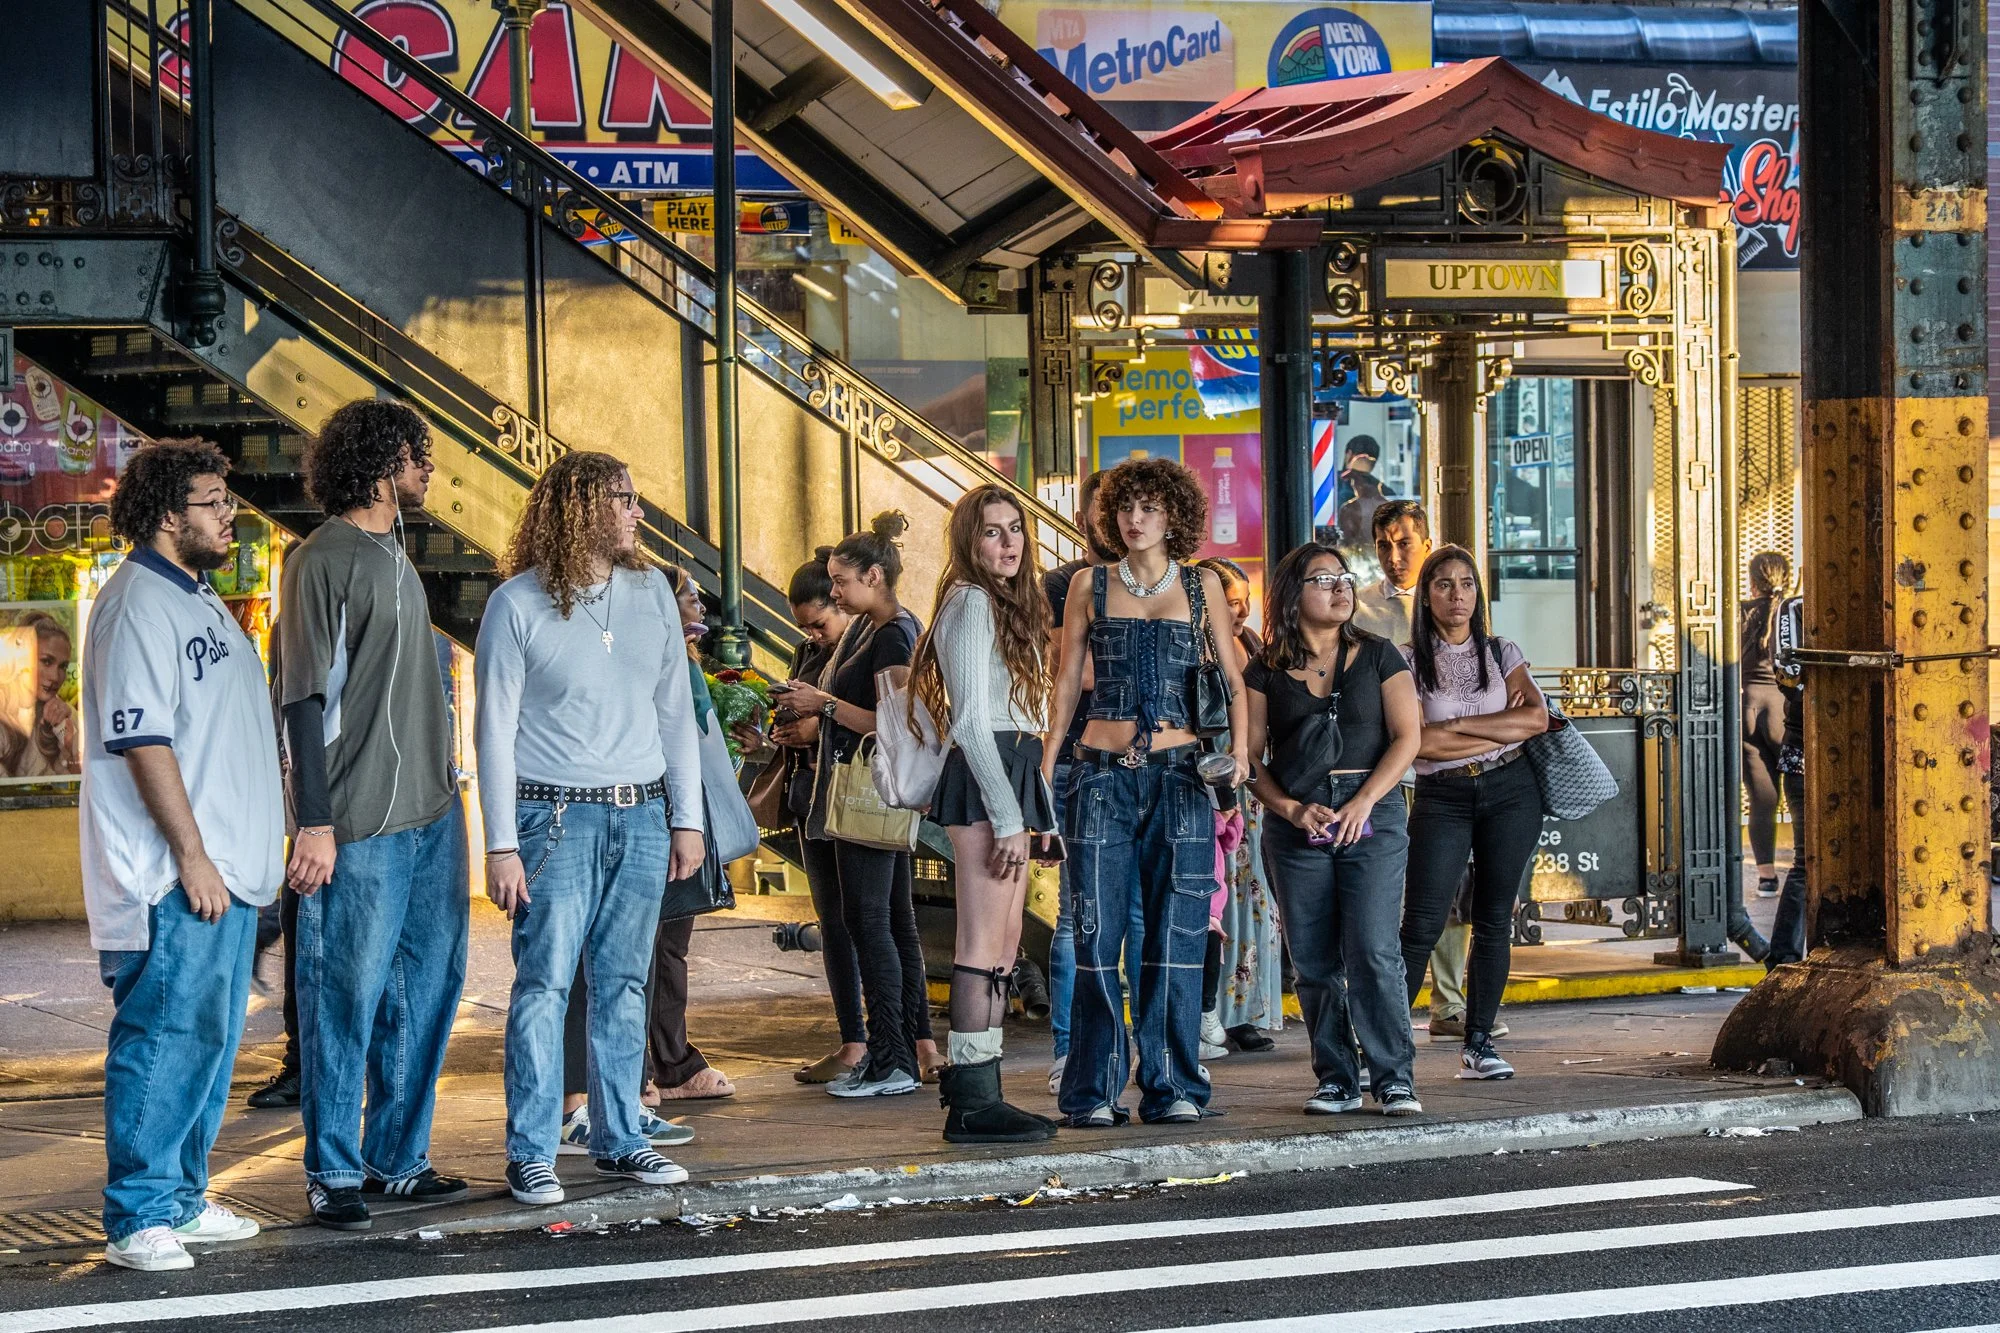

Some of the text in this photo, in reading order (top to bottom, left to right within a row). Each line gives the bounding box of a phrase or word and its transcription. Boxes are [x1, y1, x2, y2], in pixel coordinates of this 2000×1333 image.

[1324, 22, 1367, 45] NEW
[1037, 20, 1220, 95] MetroCard
[1329, 45, 1381, 76] YORK
[1589, 87, 1679, 130] Estilo
[610, 161, 679, 184] ATM
[667, 202, 708, 216] PLAY
[1428, 264, 1560, 291] UPTOWN
[1118, 368, 1197, 391] lemo
[1513, 437, 1549, 464] OPEN
[112, 708, 144, 734] 67
[1531, 851, 1600, 874] 238 St
